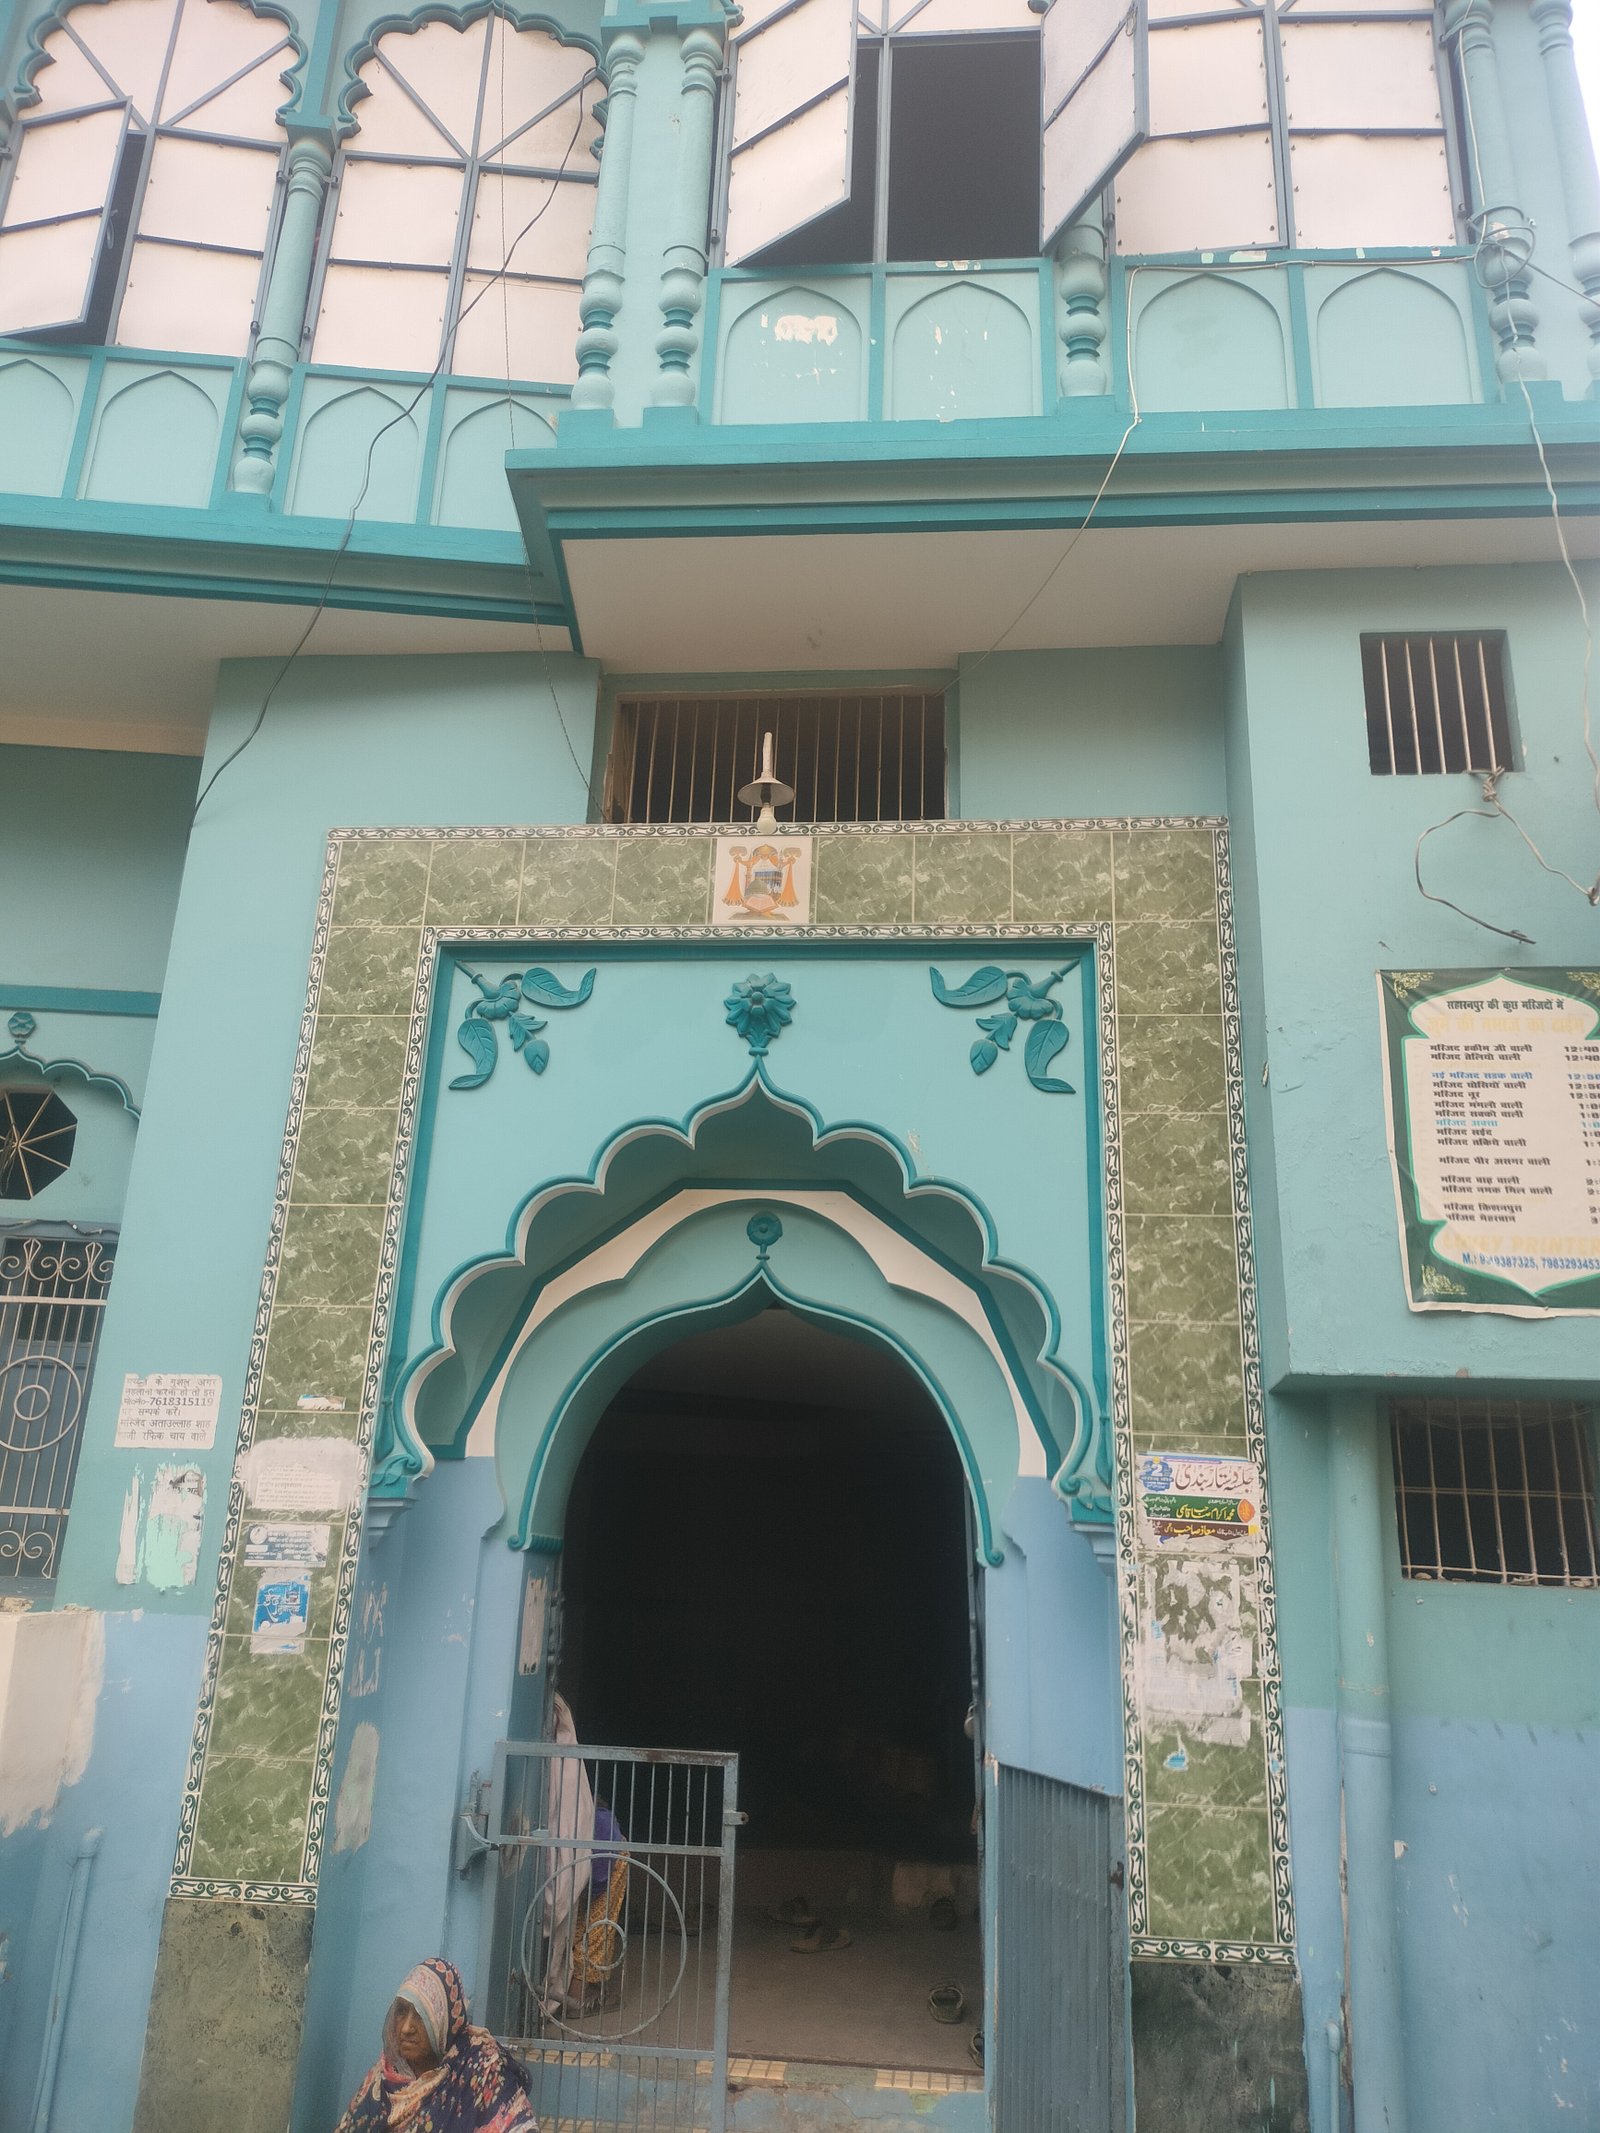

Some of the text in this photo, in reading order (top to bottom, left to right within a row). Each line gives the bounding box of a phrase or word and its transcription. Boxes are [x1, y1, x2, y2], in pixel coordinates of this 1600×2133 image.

[1446, 1000, 1484, 1012] सहारनपुर
[1488, 999, 1500, 1010] की
[1503, 1001, 1518, 1012] कुछ
[1556, 999, 1564, 1010] में
[1430, 1044, 1460, 1052] मस्जिद
[1430, 1053, 1461, 1061] मस्जिद
[1432, 1081, 1463, 1089] मस्जिद
[1433, 1090, 1464, 1098] मस्जिद
[1434, 1101, 1465, 1109] मस्जिद
[1435, 1110, 1466, 1118] मस्जिद
[1436, 1128, 1468, 1137] मस्जिद
[1437, 1138, 1469, 1146] मस्जिद
[1439, 1156, 1470, 1165] मस्जिद
[155, 1376, 163, 1386] के
[192, 1386, 200, 1397] तो
